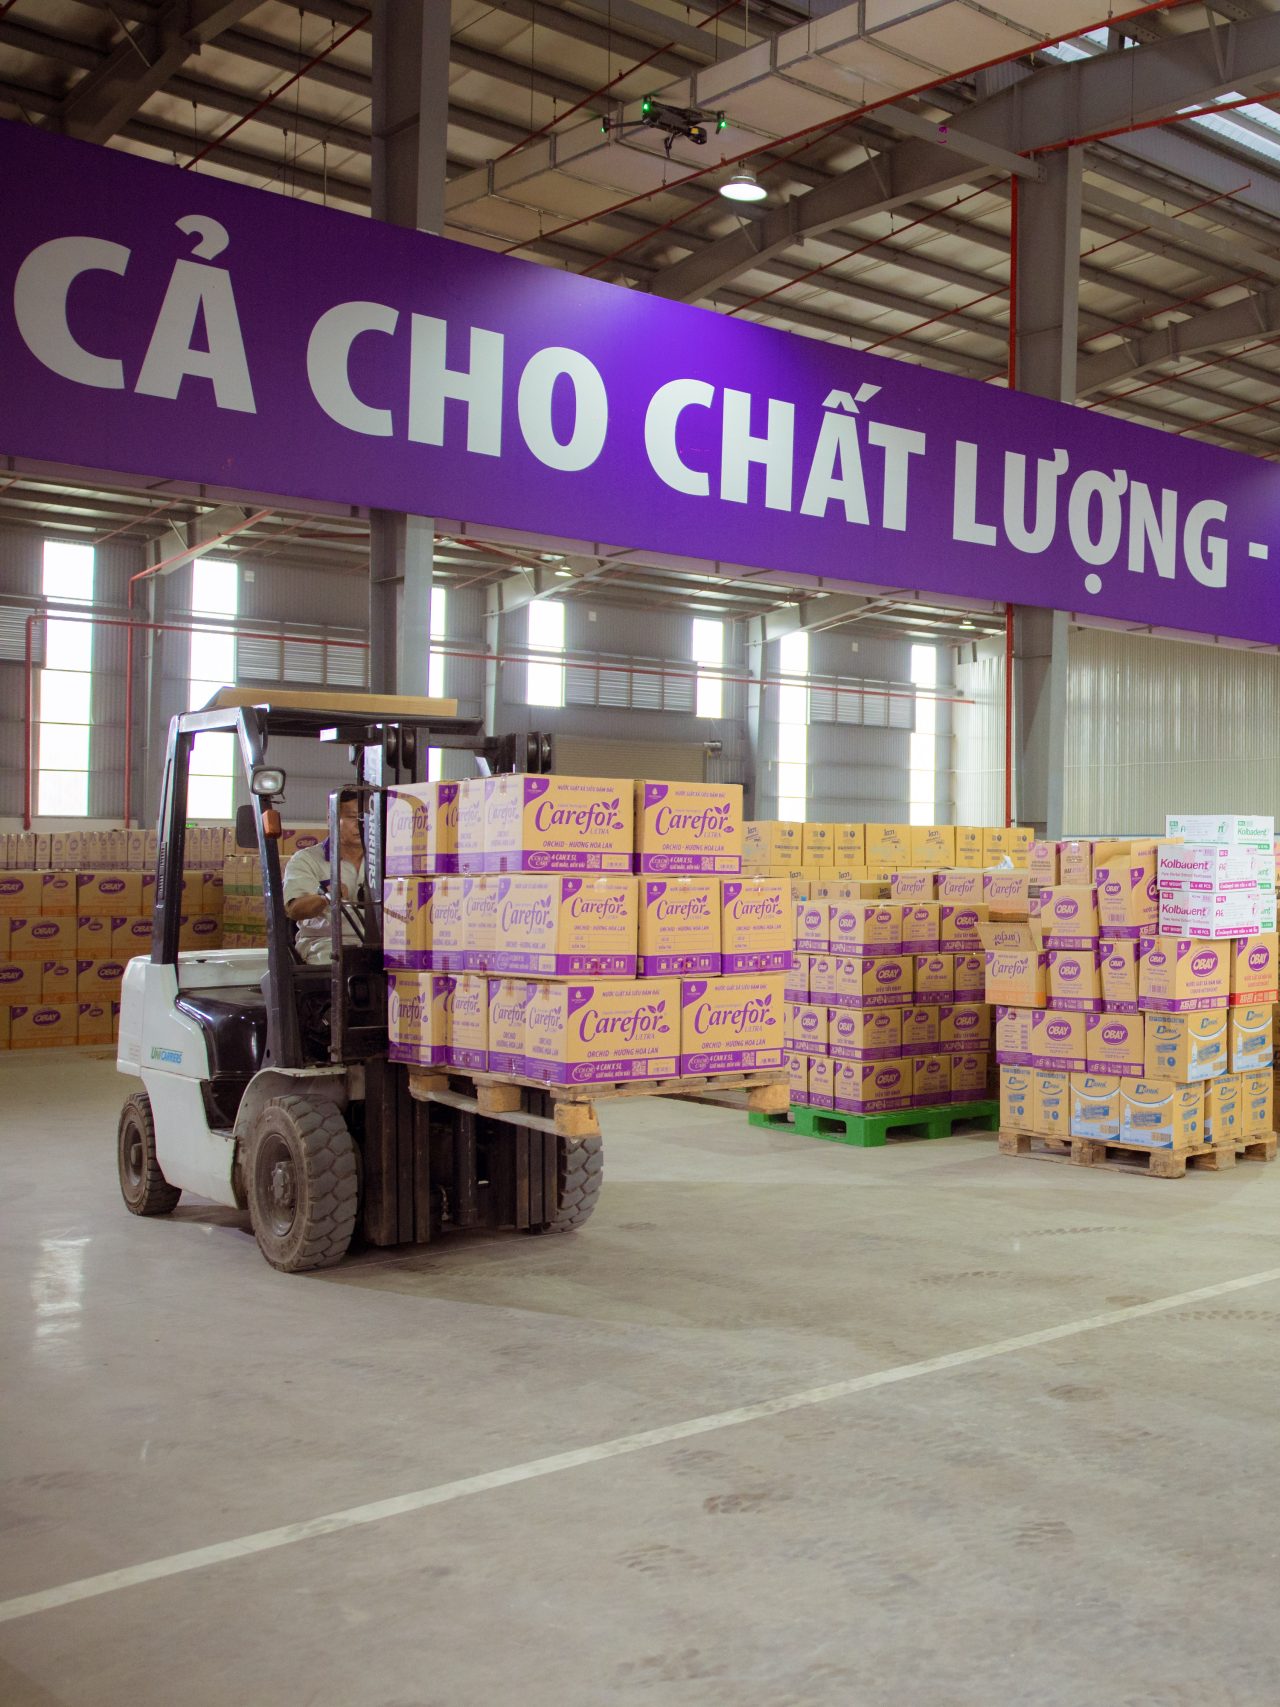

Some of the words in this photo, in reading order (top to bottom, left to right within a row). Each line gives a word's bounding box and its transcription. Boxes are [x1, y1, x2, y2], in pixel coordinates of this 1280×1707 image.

[14, 214, 257, 414] CẢ
[306, 301, 608, 471] CHO
[645, 382, 926, 531] CHẤT
[953, 441, 1228, 594] LƯỢNG
[1248, 542, 1268, 559] -
[535, 800, 618, 835] Carefor
[656, 806, 729, 838] Carefor
[502, 900, 550, 935] Carefor
[571, 897, 623, 920] Carefor
[656, 900, 707, 920] Carefor
[733, 900, 780, 920] Carefor
[992, 958, 1027, 979] Carefor
[579, 1007, 664, 1042] Carefor
[694, 1001, 770, 1034] Carefor
